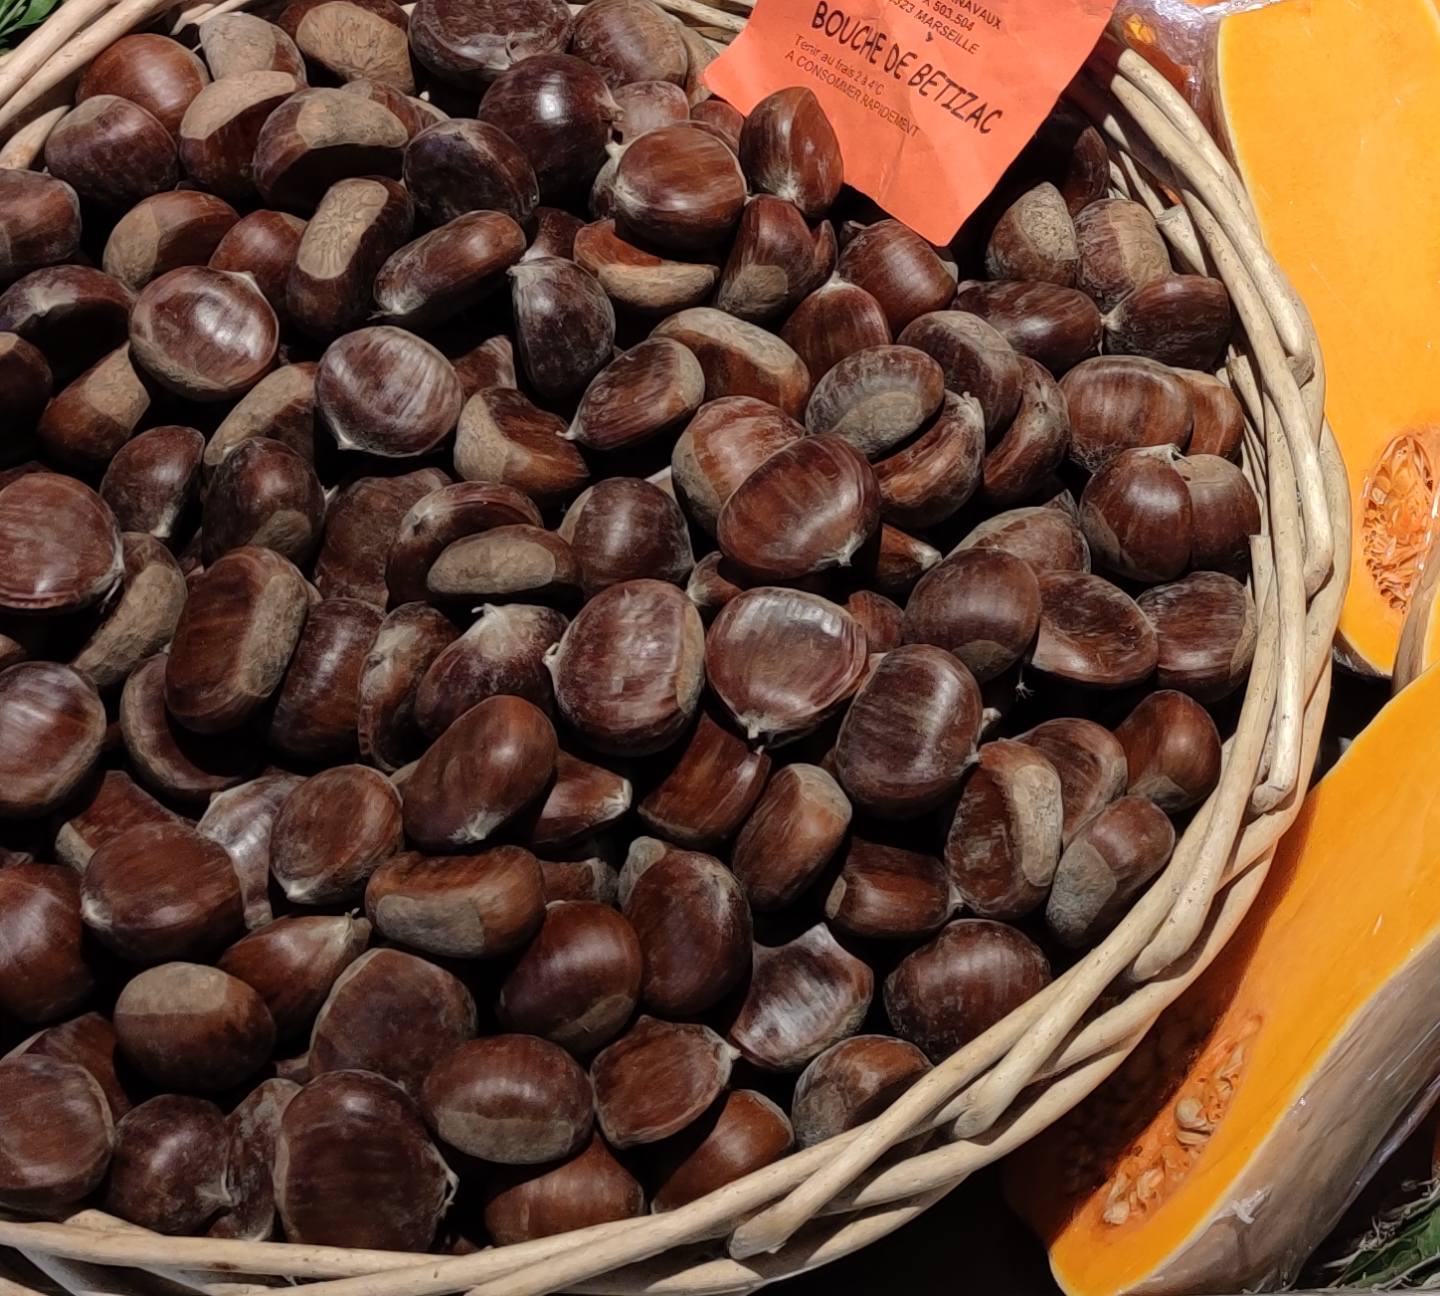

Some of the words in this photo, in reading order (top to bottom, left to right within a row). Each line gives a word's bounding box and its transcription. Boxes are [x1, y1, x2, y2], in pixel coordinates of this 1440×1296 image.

[794, 33, 821, 56] Tenir
[819, 52, 835, 66] au
[834, 58, 855, 78] frais
[914, 9, 979, 54] MARSEILLE
[795, 55, 861, 101] CONSOMMER
[859, 93, 920, 136] RAPIDEMENT
[811, 0, 886, 63] BOUCHE
[883, 42, 918, 79] DE
[907, 63, 1002, 133] BETIZAC
